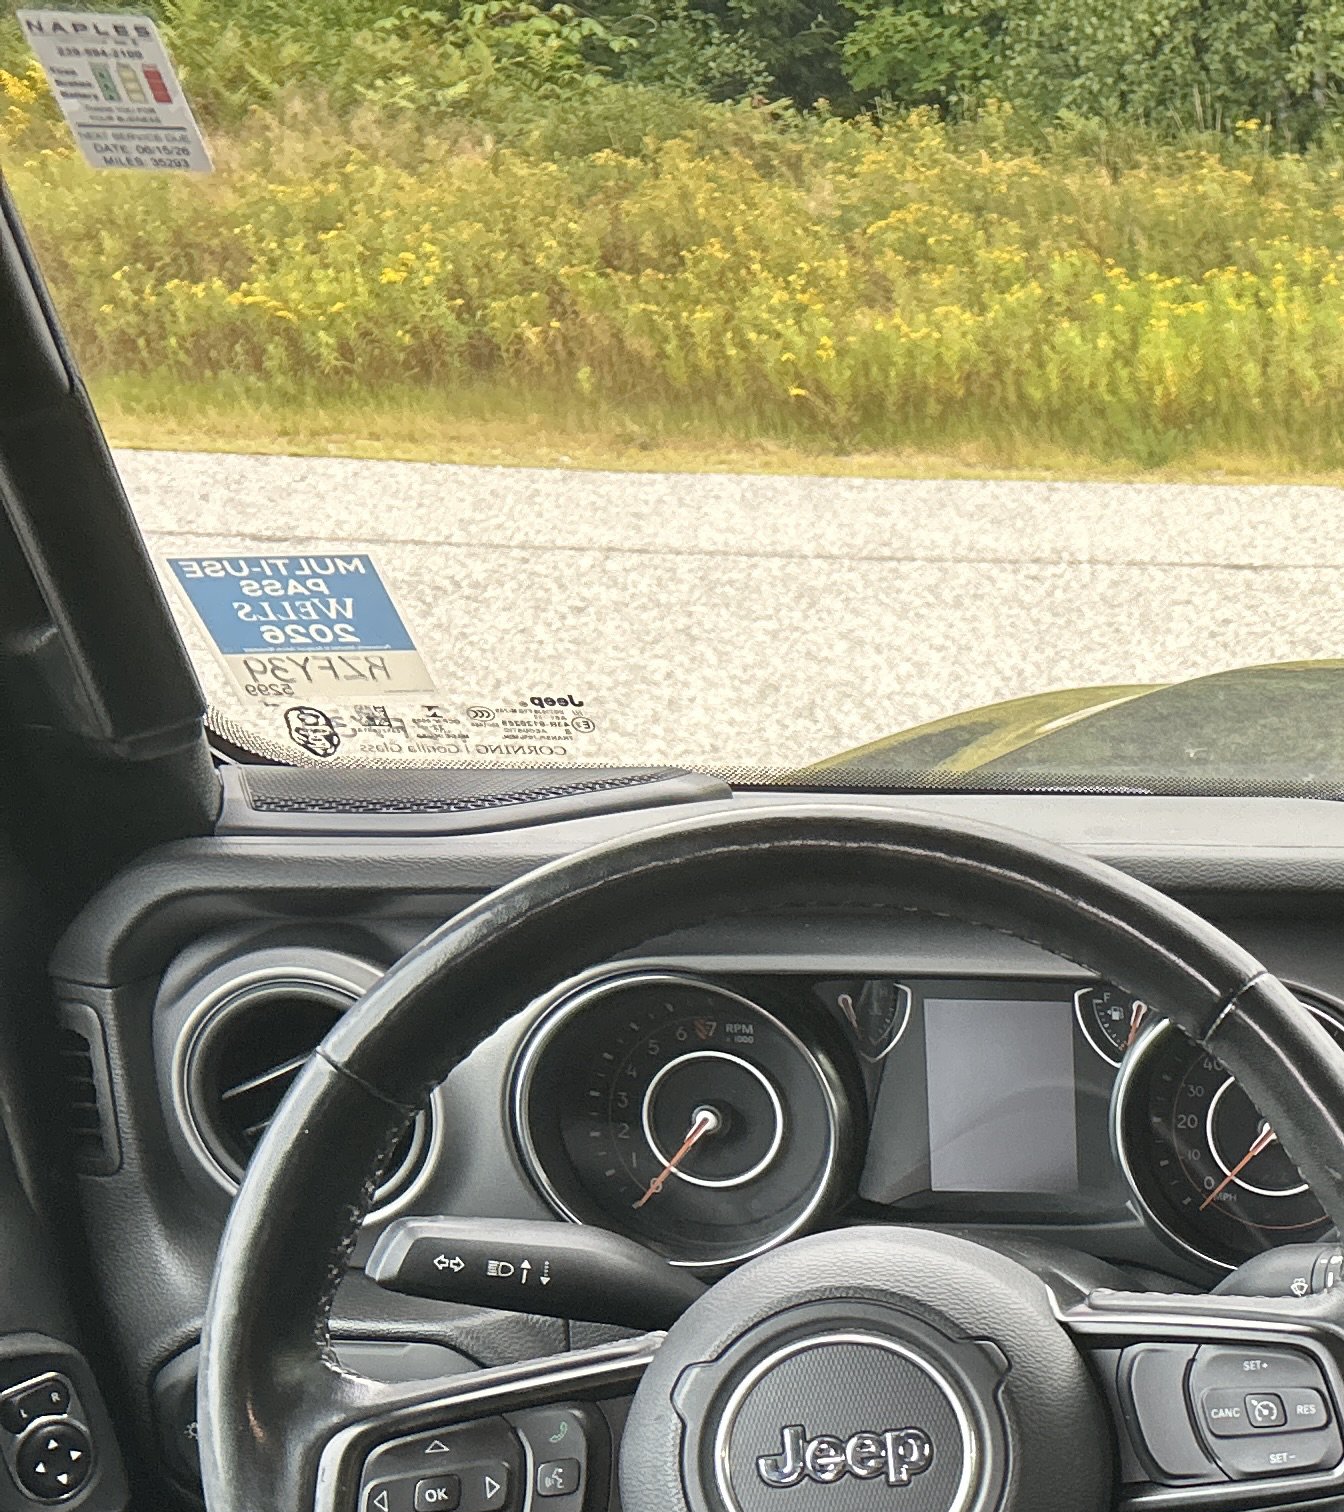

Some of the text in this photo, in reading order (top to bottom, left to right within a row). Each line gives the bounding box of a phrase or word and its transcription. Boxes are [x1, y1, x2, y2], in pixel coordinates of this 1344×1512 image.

[26, 19, 151, 38] NAPLES
[1103, 992, 1111, 1002] F
[676, 1026, 687, 1041] 6
[725, 1023, 754, 1034] RPM
[649, 1040, 660, 1055] 5
[627, 1065, 637, 1078] 4
[1187, 1085, 1204, 1097] 30
[617, 1092, 628, 1108] 3
[1177, 1115, 1198, 1129] 20
[618, 1123, 630, 1139] 2
[1204, 1176, 1215, 1190] 0
[50, 1392, 60, 1403] R
[20, 1409, 28, 1418] L
[1210, 1407, 1241, 1419] CANC
[1296, 1404, 1316, 1415] RES
[757, 1424, 935, 1489] Jeep
[424, 1487, 449, 1504] OK
